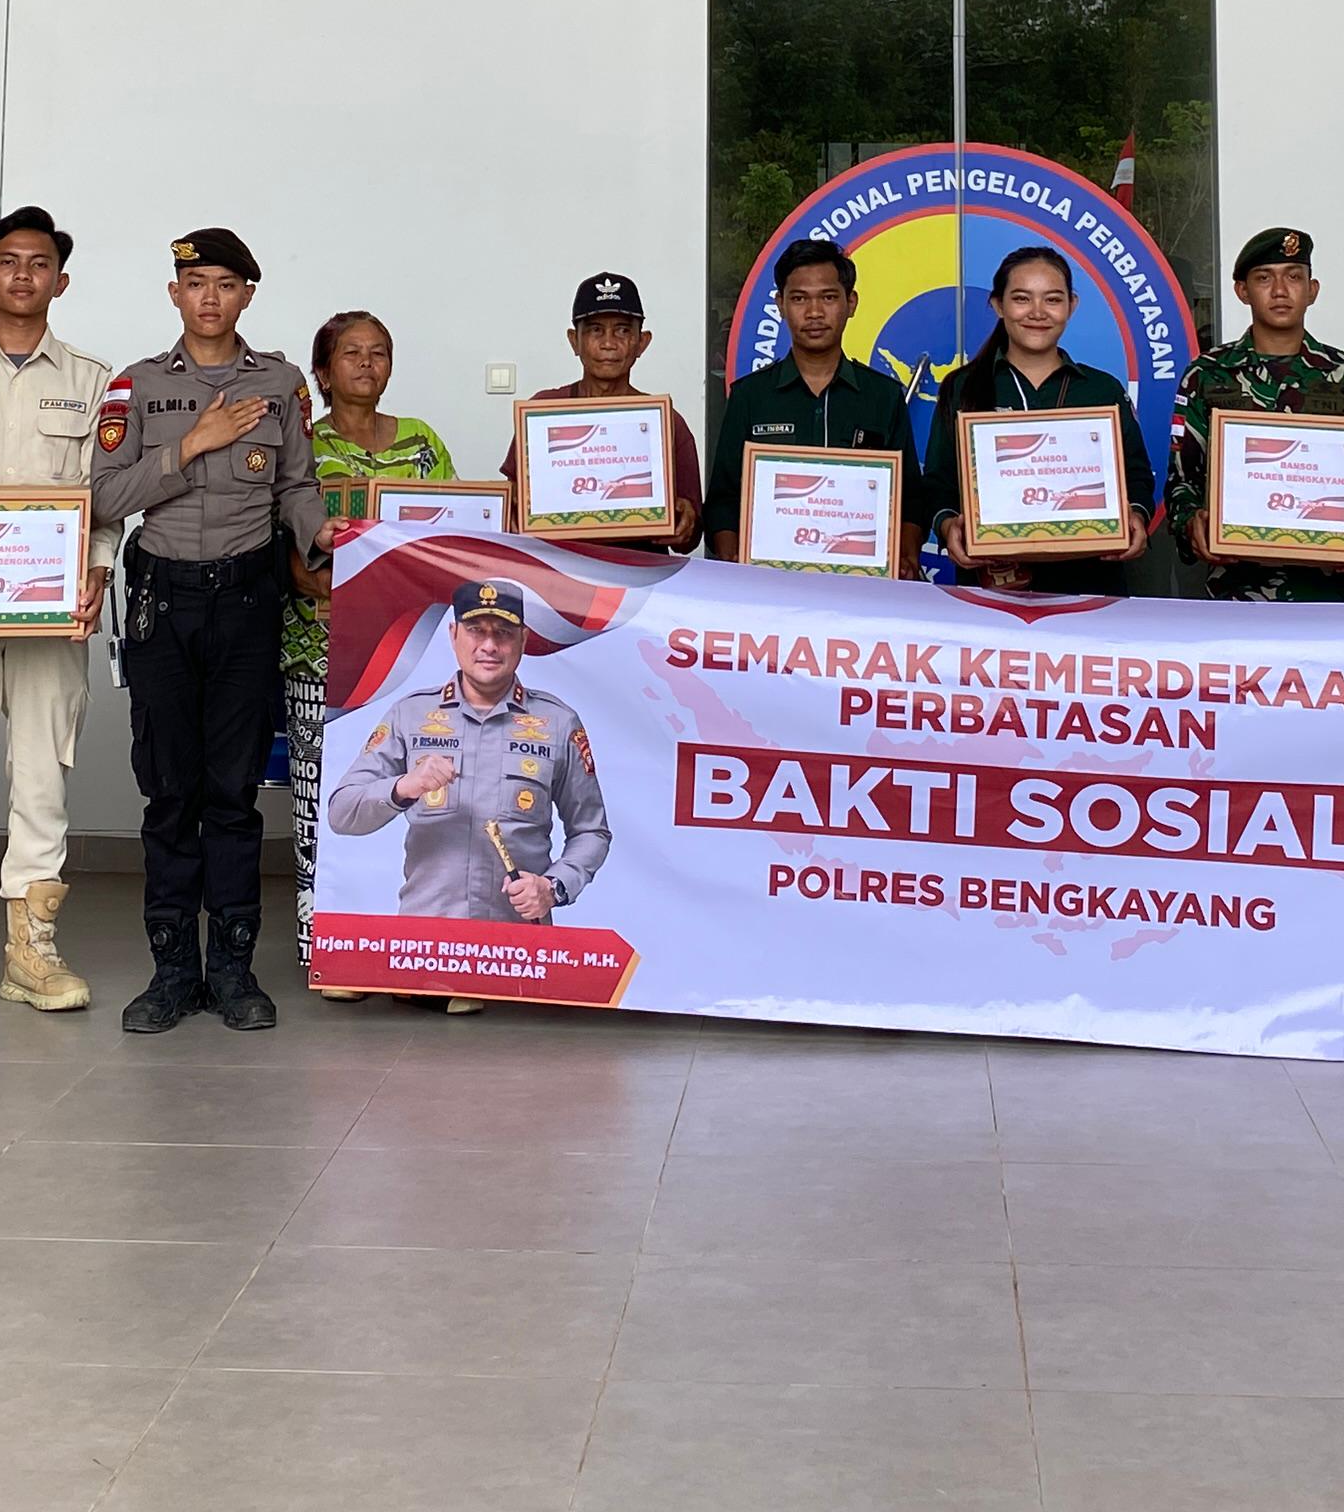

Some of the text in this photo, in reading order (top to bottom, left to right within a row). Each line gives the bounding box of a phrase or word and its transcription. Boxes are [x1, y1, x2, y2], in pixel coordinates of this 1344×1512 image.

[907, 169, 1072, 222] PENGELOLA
[1075, 211, 1176, 380] PERBATASAN
[596, 293, 621, 301] adidas
[582, 445, 617, 454] BANSOS
[552, 455, 648, 467] POLRES BENGKAYANG
[1031, 454, 1068, 464] BANSOS
[1280, 461, 1318, 471] BANSOS
[1000, 464, 1101, 477] POLRES BENGKAYANG
[1248, 471, 1284, 482] POLRES
[808, 497, 843, 507] BANSOS
[776, 507, 874, 521] POLRES BENGKAYANG
[665, 628, 942, 685] SEMARAK
[840, 686, 1216, 751] PERBATASAN
[509, 741, 551, 757] POLRI
[692, 753, 977, 838] BAKTI
[768, 864, 1276, 931] POLRES BENGKAYANG
[316, 936, 354, 952] Irjen
[359, 938, 384, 952] Pol
[390, 940, 433, 955] PIPIT
[438, 942, 532, 964] RISMANTO,
[583, 953, 620, 968] M.H.
[389, 957, 547, 979] KAPOLDA KALBAR
